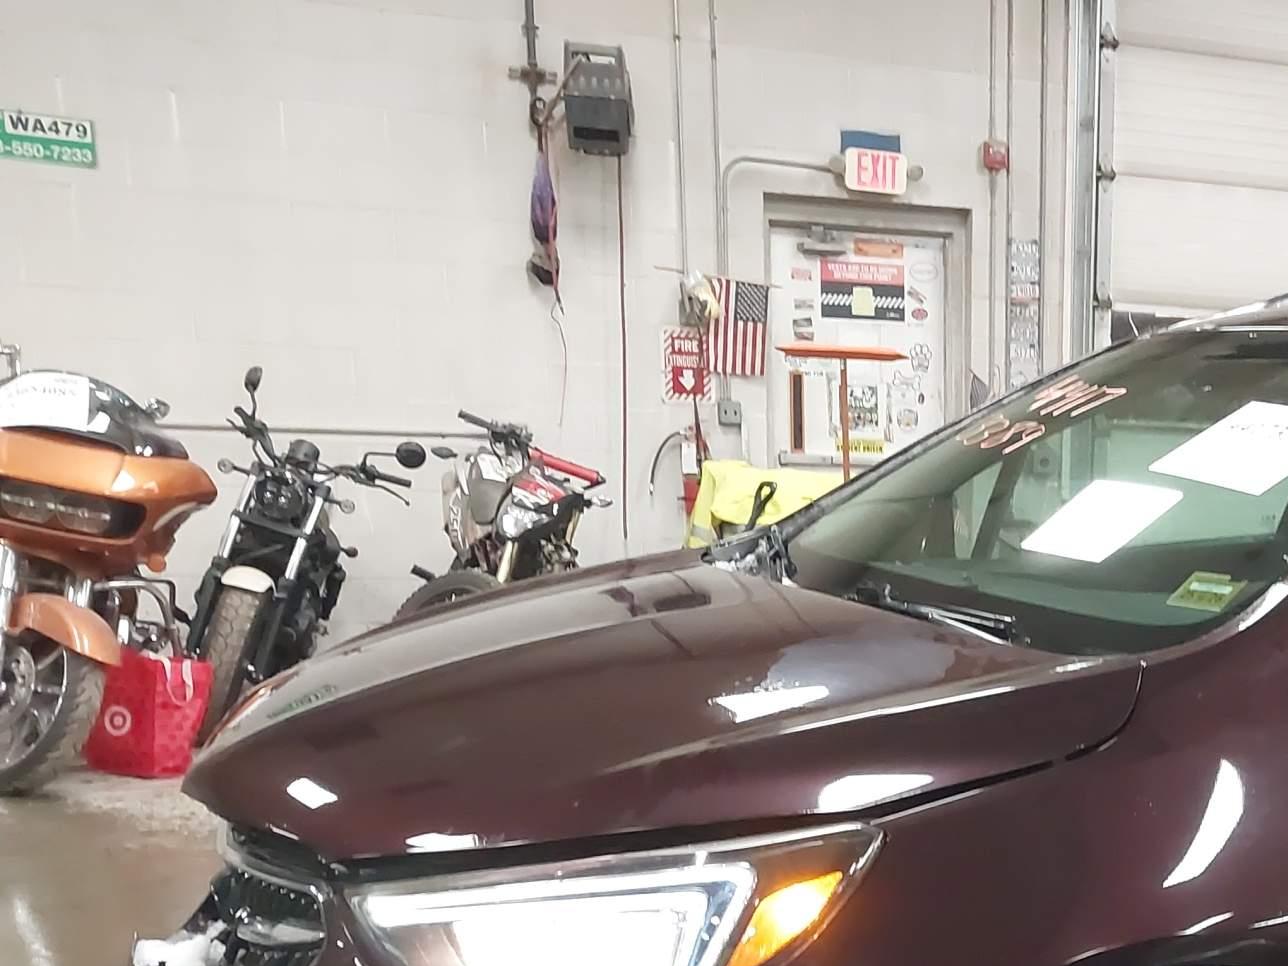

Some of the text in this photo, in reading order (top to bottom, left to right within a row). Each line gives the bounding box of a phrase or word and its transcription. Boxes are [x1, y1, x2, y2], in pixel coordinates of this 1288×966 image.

[8, 114, 88, 139] WA479
[857, 151, 899, 190] EXIT
[674, 338, 699, 353] FIRE
